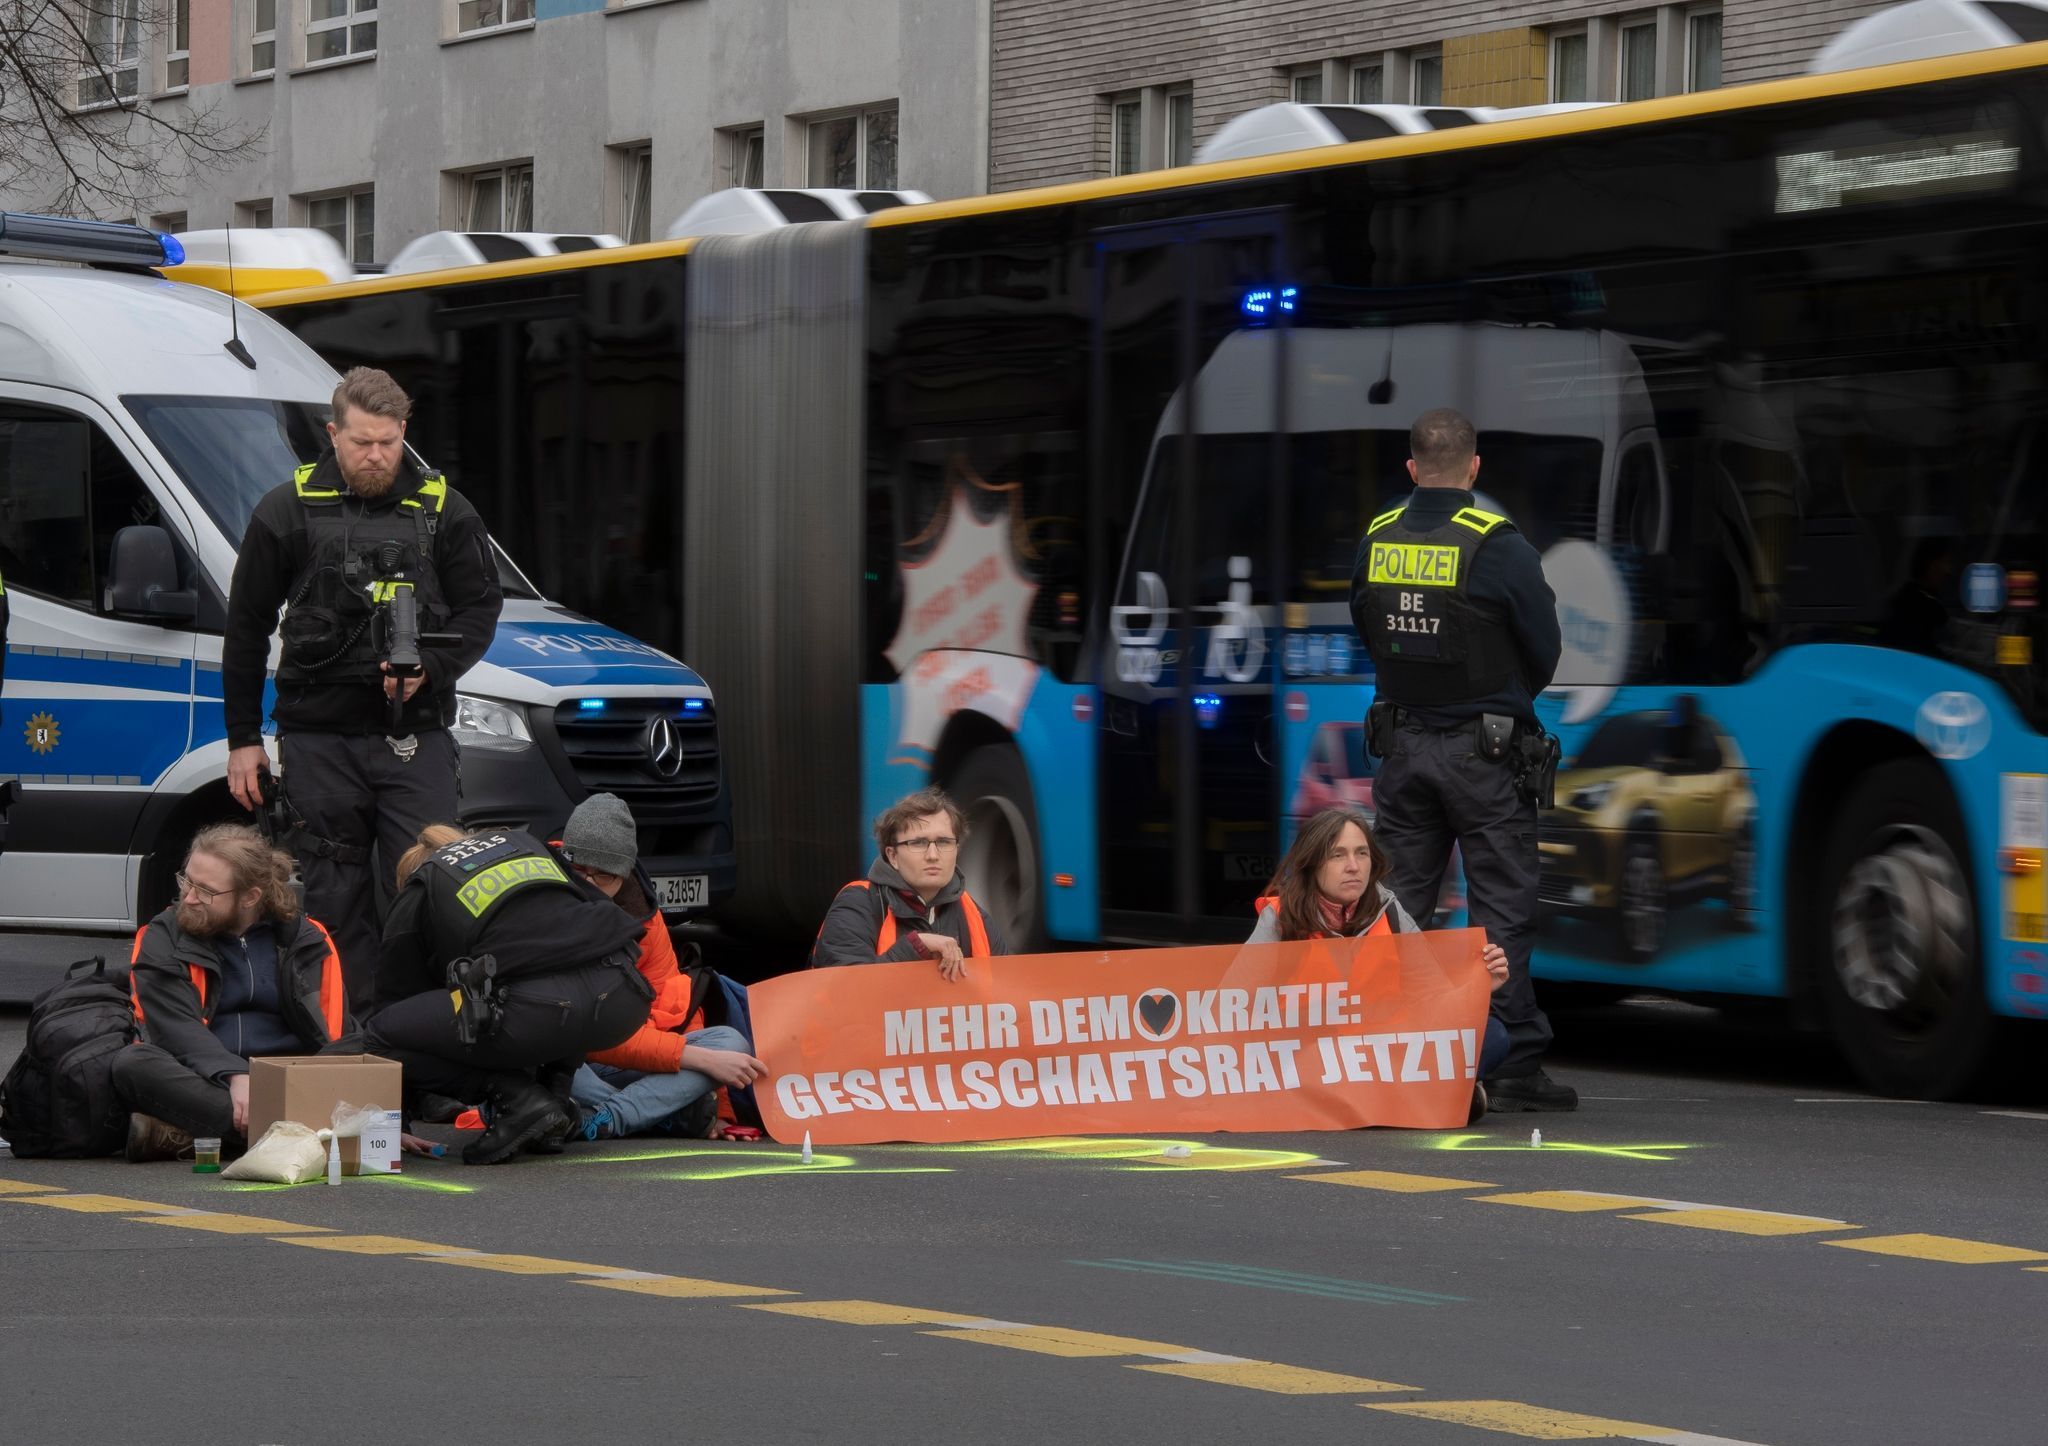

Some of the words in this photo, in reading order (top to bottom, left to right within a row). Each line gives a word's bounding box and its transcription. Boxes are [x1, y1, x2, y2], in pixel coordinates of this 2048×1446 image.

[1372, 547, 1456, 582] POLIZEI
[1400, 591, 1424, 613] BE
[1386, 614, 1441, 635] 31117
[512, 634, 658, 657] POLIZEI
[442, 834, 507, 866] 31115
[461, 858, 560, 913] POLIZEI
[666, 878, 702, 904] 31857
[884, 1003, 1019, 1057] MEHR
[775, 1039, 1301, 1120] GESELLSCHAFTSRAT
[1317, 1028, 1477, 1085] JETZT!
[370, 1139, 387, 1149] 100
